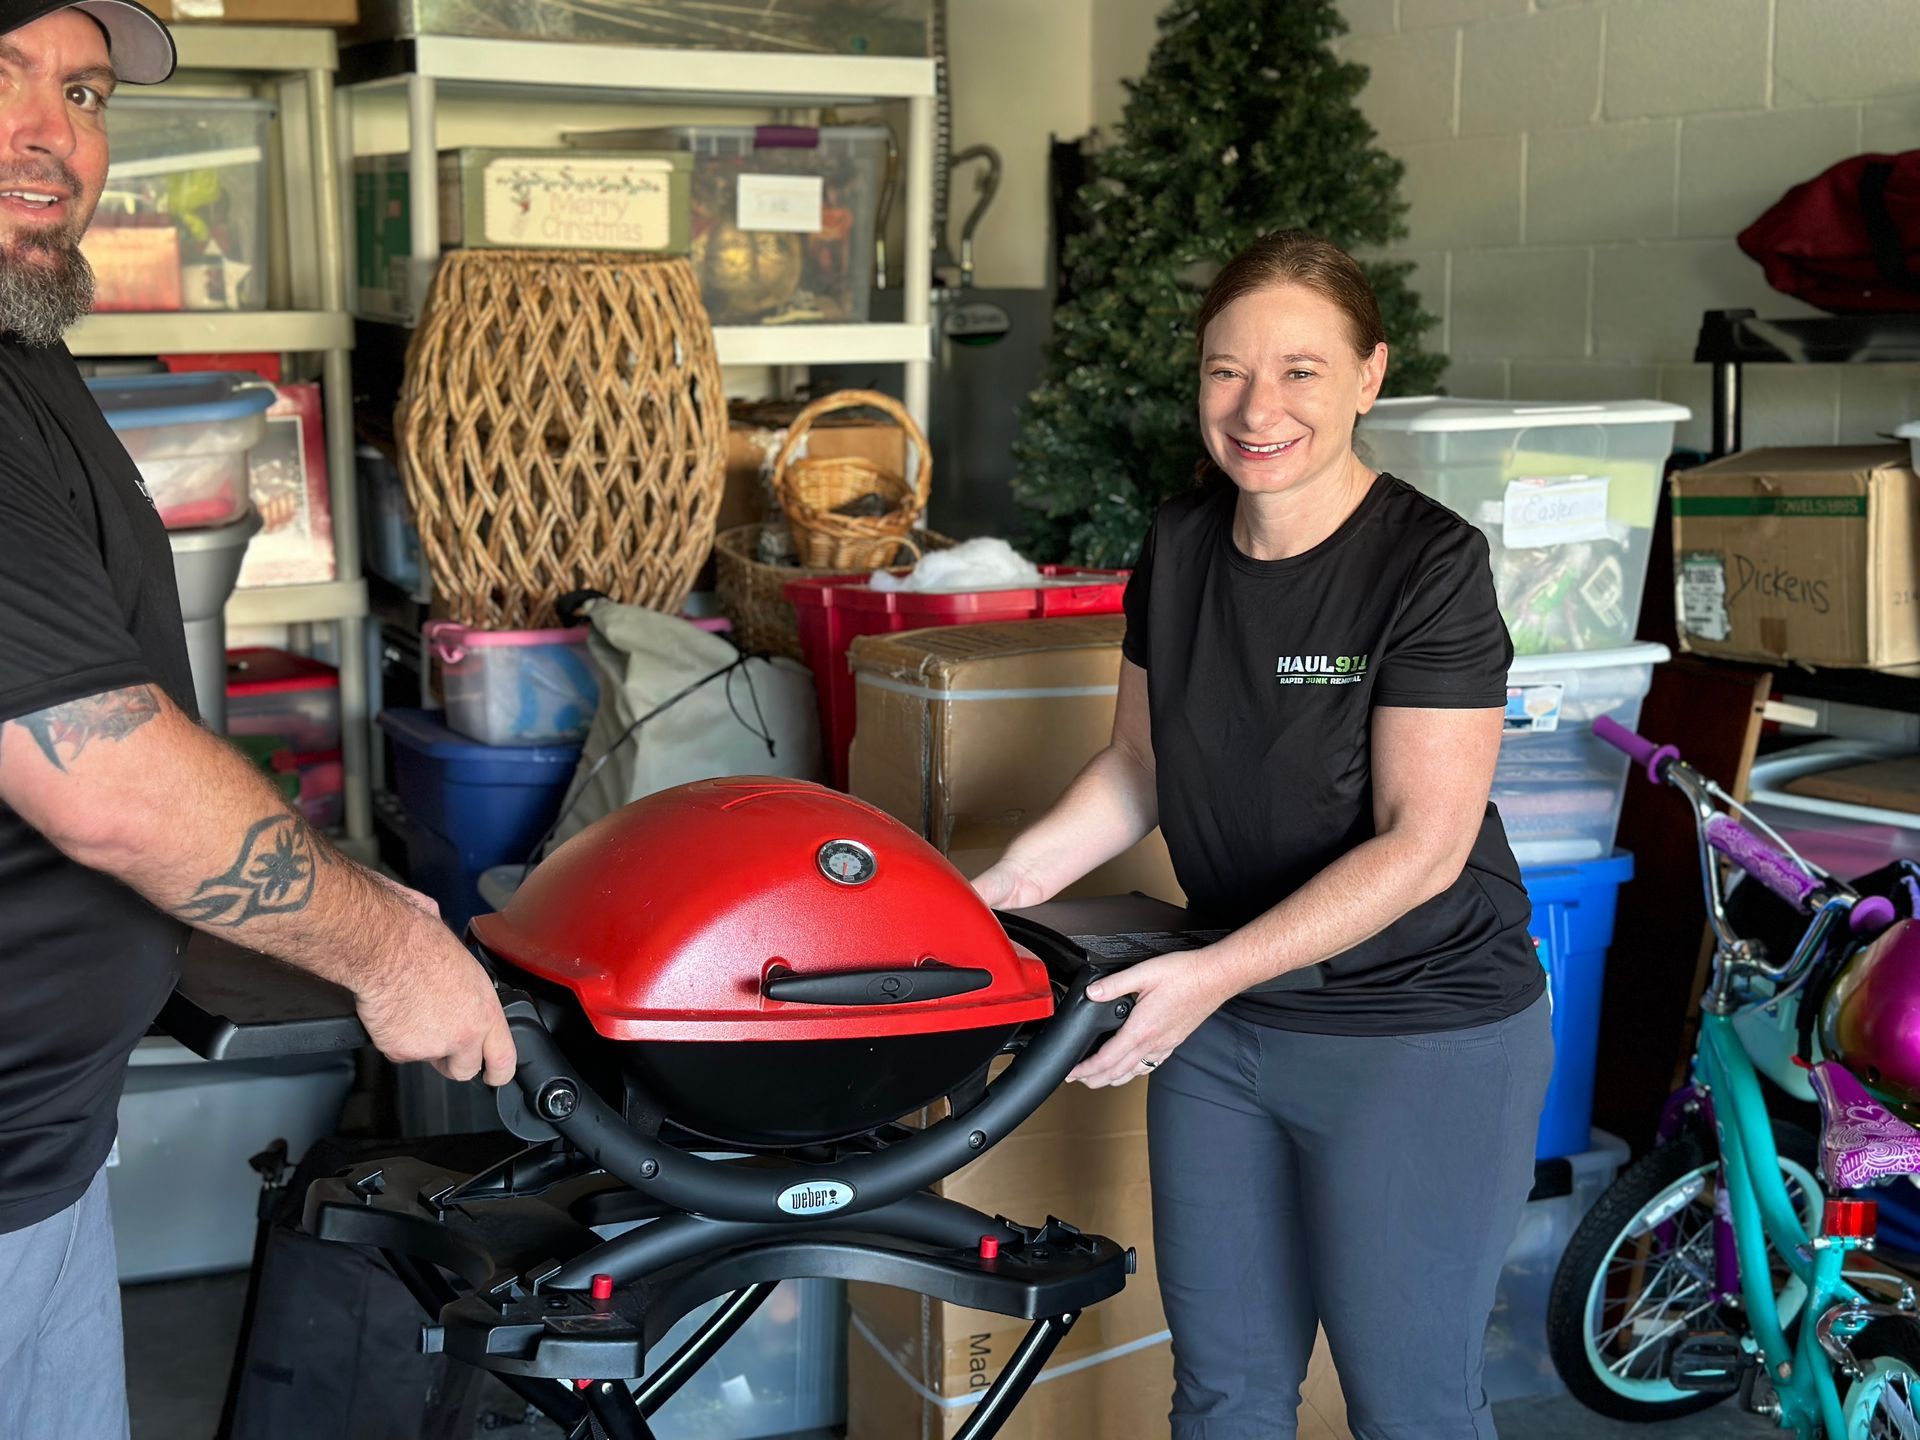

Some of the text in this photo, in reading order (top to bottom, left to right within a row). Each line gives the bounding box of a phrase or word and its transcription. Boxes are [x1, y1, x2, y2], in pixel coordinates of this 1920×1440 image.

[550, 192, 630, 220] Merry
[541, 214, 643, 242] Christmas
[1523, 495, 1579, 523] Easter
[1729, 554, 1829, 613] Dickens
[1279, 677, 1303, 685] RAPID
[1305, 677, 1328, 685] JUNK
[791, 1186, 828, 1209] weber
[969, 1332, 992, 1393] Mad
